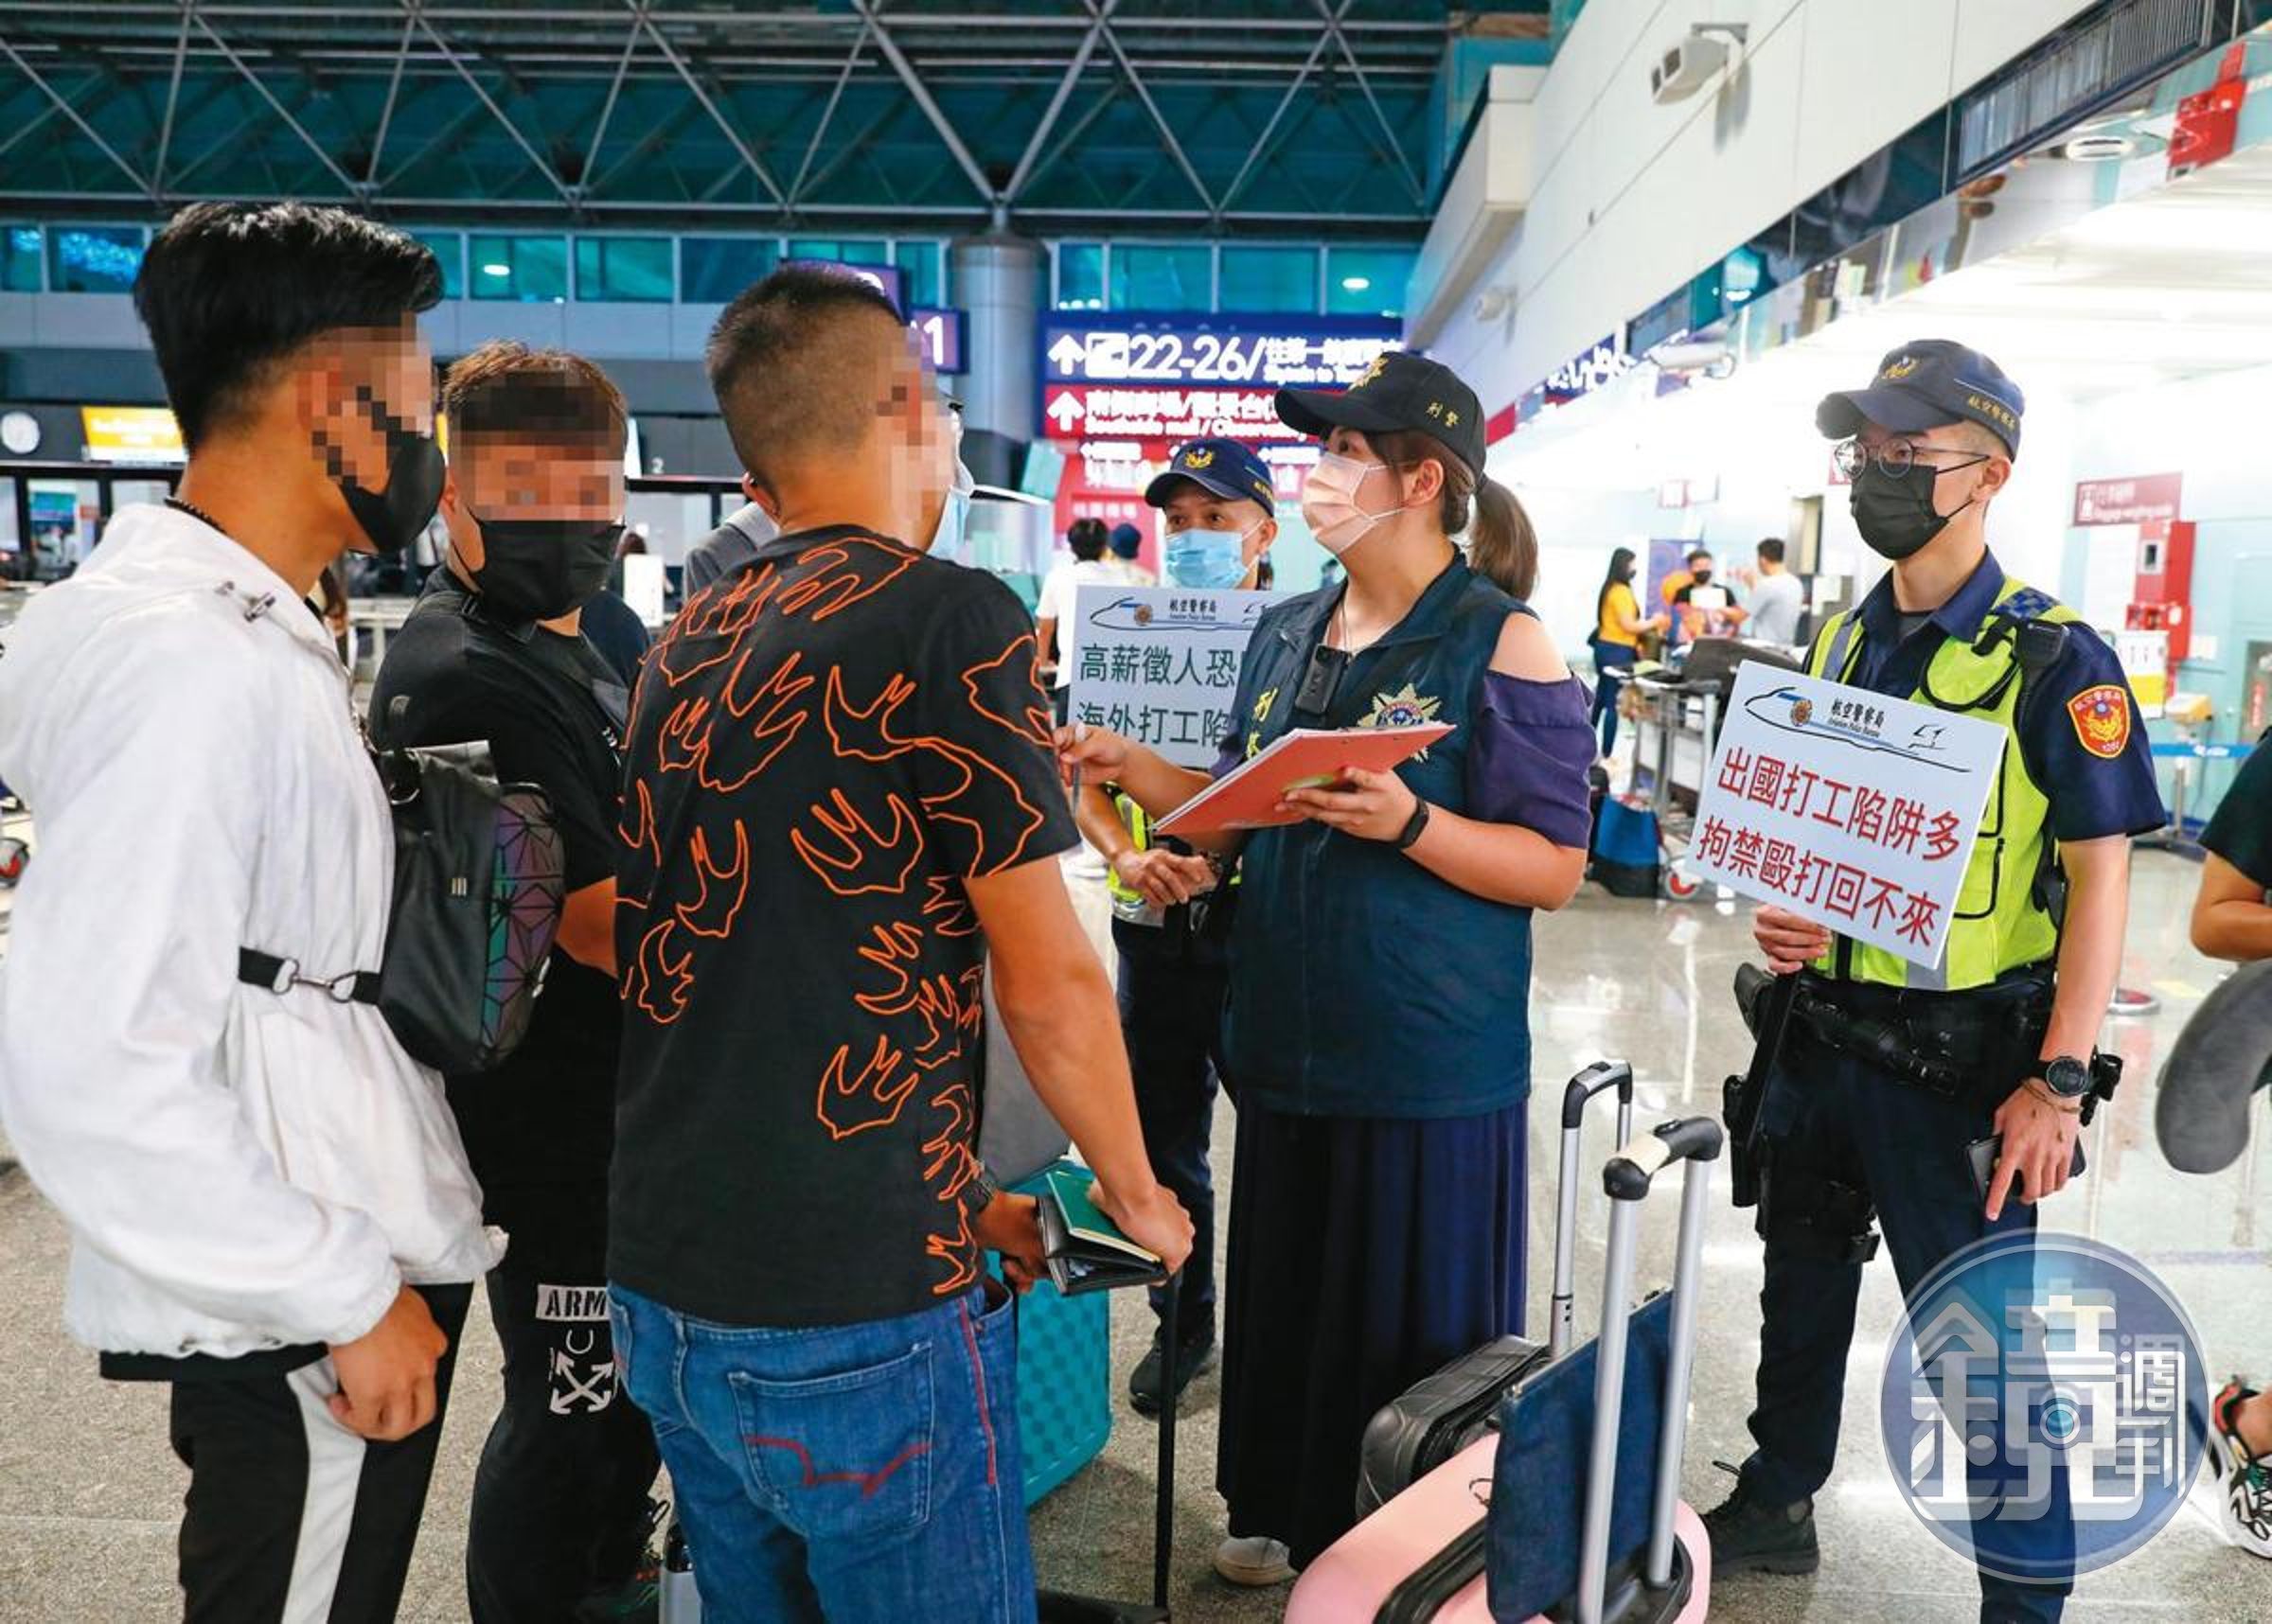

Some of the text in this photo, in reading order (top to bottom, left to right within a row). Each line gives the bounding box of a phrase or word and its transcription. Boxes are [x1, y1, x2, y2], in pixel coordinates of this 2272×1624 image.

[1079, 644, 1244, 688] 高薪徵人恐
[1718, 746, 1961, 862] 出國打工陷阱多
[1695, 816, 1941, 947] 拘禁毆打回不來
[545, 1289, 606, 1317] ARM
